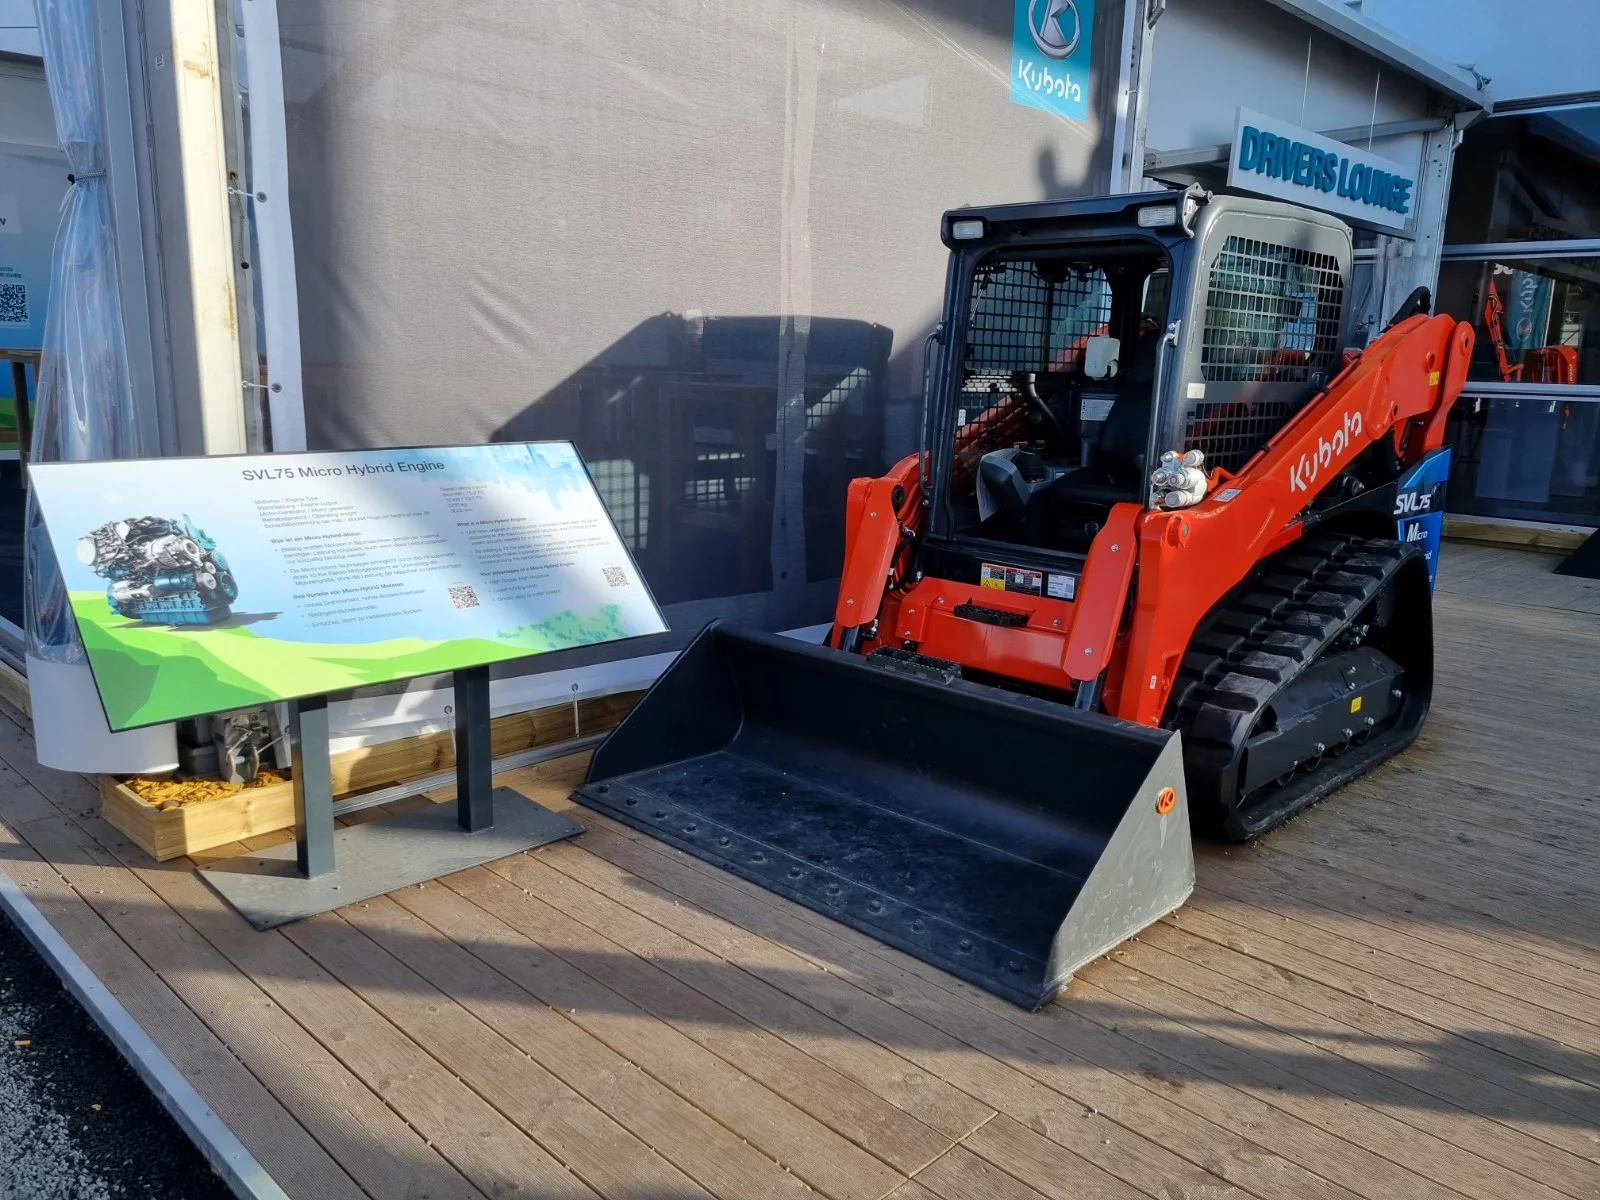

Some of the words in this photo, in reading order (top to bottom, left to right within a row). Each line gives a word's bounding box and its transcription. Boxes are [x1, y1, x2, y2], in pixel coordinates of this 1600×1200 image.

[1017, 59, 1082, 104] Kubota
[1239, 125, 1338, 192] DRIVERS
[1337, 157, 1414, 214] LOUNGE
[1290, 411, 1362, 492] Kubota
[242, 468, 295, 481] SVL75
[299, 464, 342, 478] Micro
[345, 463, 394, 479] Hybrid
[399, 460, 446, 475] Engine
[1393, 492, 1432, 515] SVL75
[1407, 522, 1428, 543] Micro
